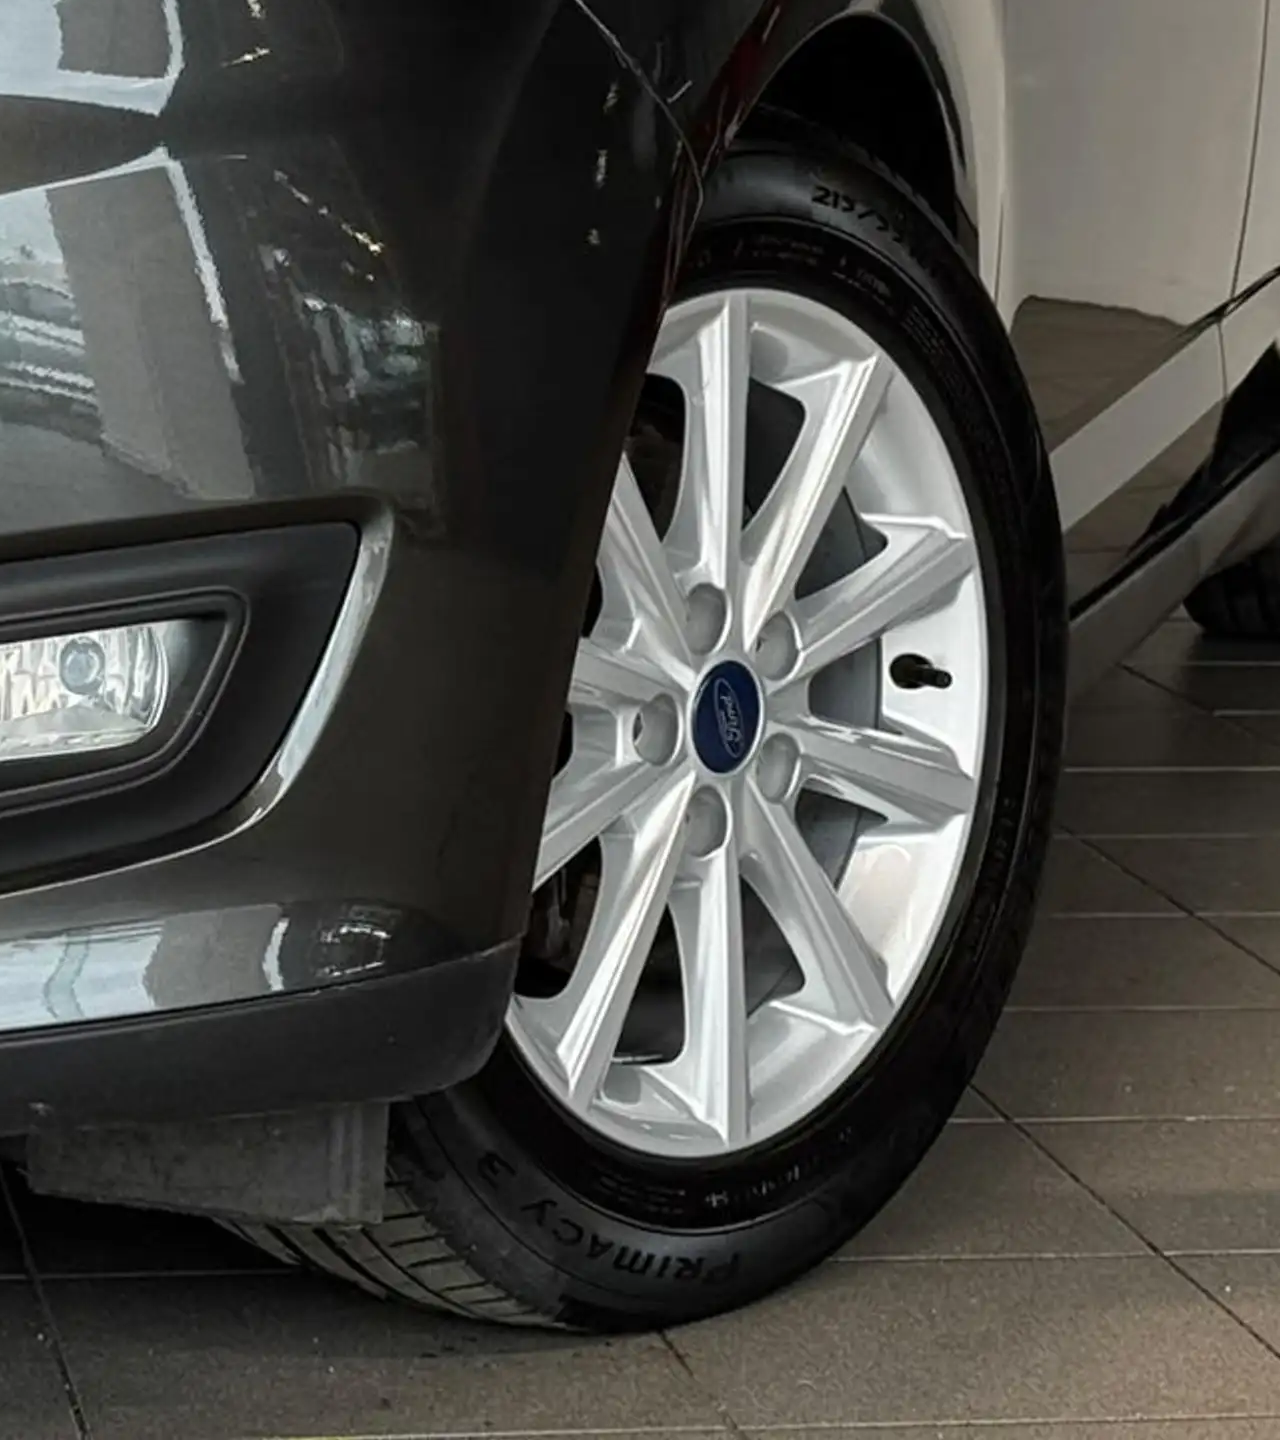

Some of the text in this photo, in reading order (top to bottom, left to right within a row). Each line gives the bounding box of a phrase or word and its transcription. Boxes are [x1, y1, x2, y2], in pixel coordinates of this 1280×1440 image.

[717, 690, 743, 748] Ford
[475, 1150, 741, 1284] PRIMACY 3
